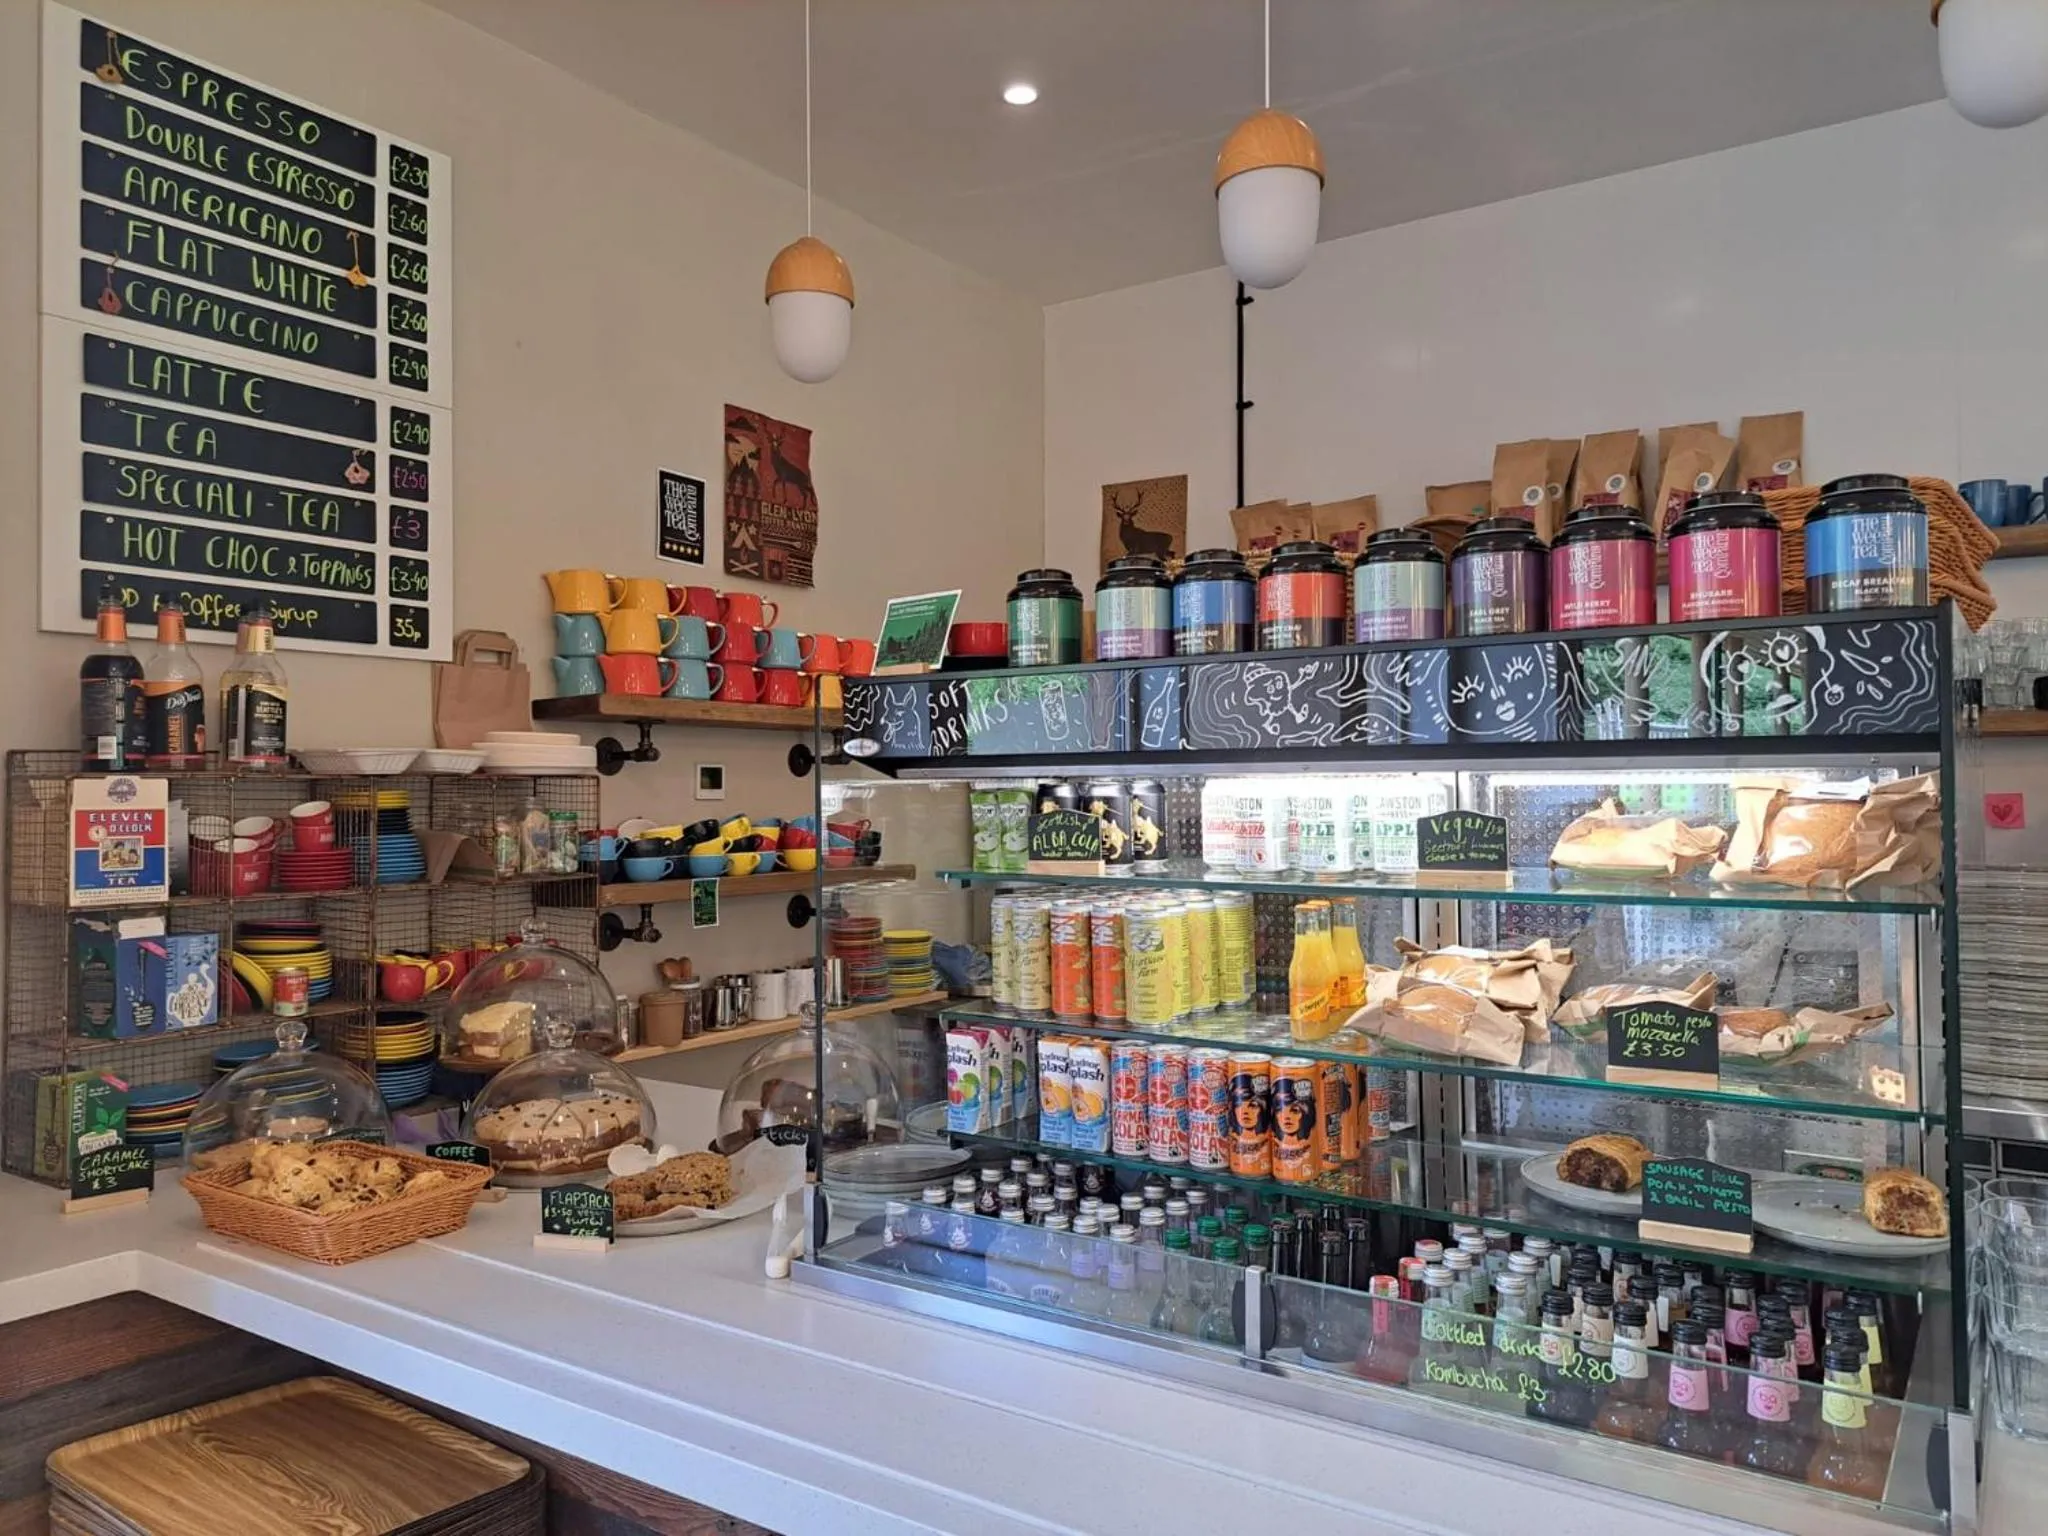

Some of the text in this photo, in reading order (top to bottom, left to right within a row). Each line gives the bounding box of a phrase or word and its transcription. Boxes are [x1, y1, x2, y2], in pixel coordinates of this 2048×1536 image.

[121, 48, 321, 145] ESPRESSO
[125, 106, 230, 173] DOUBLE
[246, 151, 356, 211] ESPRESSO
[123, 166, 324, 255] AMERICANO
[127, 219, 224, 277] FLAT
[251, 255, 337, 313] WHITE
[125, 280, 320, 354] CAPPUCCINO
[127, 348, 270, 414] LATTE
[119, 408, 218, 460] TEA
[123, 521, 185, 567] HOT
[205, 535, 280, 578] CHOC
[299, 551, 373, 590] TOPPINGS
[1831, 578, 1861, 590] DECAF
[926, 680, 972, 720] SOFT
[937, 687, 1008, 748] DRINKS
[89, 812, 153, 822] ELEVEN
[1431, 816, 1484, 843] Vegan
[1033, 830, 1067, 851] ALBA
[1071, 831, 1099, 854] COLA
[108, 877, 136, 886] TEA
[1622, 1040, 1686, 1057] £3.50
[80, 1148, 147, 1171] CARAMEL
[435, 1146, 476, 1158] COFFEE
[79, 1160, 150, 1183] SHORTCAKE
[1645, 1162, 1705, 1181] SAUSAGE
[550, 1190, 611, 1209] FLAPJACK
[1424, 1359, 1547, 1402] Kombucha £3
